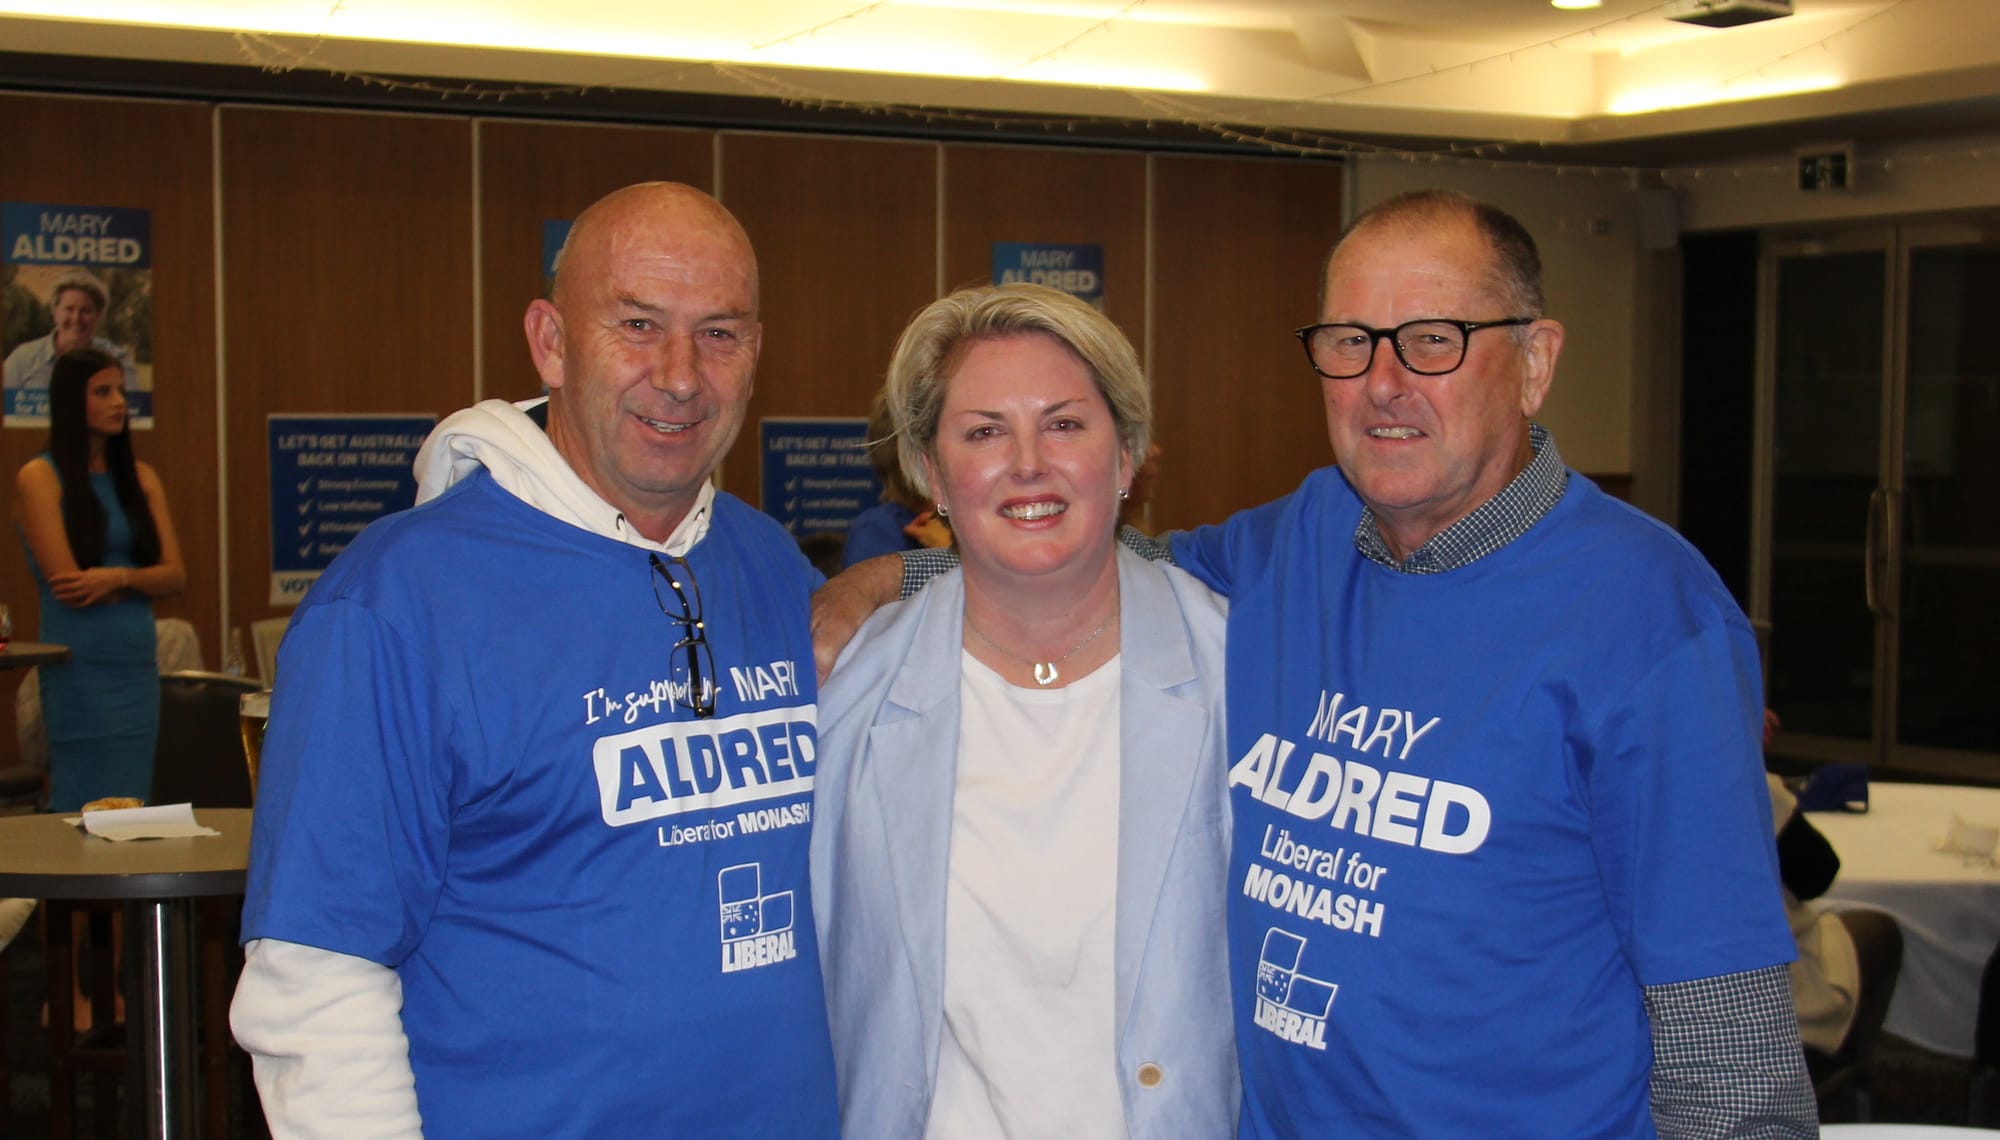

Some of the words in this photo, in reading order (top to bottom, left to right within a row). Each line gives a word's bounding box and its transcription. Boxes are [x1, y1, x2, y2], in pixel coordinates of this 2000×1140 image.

[12, 233, 142, 264] ALDRED
[40, 212, 113, 235] MARY
[1019, 250, 1075, 268] MARY
[278, 434, 317, 449] LET'S
[320, 434, 347, 449] GET
[297, 453, 334, 467] BACK
[337, 453, 358, 467] ON
[583, 687, 623, 726] I'm
[729, 660, 800, 702] MARY
[1305, 689, 1441, 760] MARY
[615, 720, 817, 813] ALDRED
[1228, 732, 1492, 855] ALDRED
[710, 819, 735, 841] for
[736, 801, 811, 834] MONASH
[1260, 823, 1344, 880] Liberal
[1343, 852, 1387, 892] for
[1243, 863, 1385, 938] MONASH
[721, 930, 797, 974] LIBERAL
[1254, 995, 1327, 1051] LIBERAL
